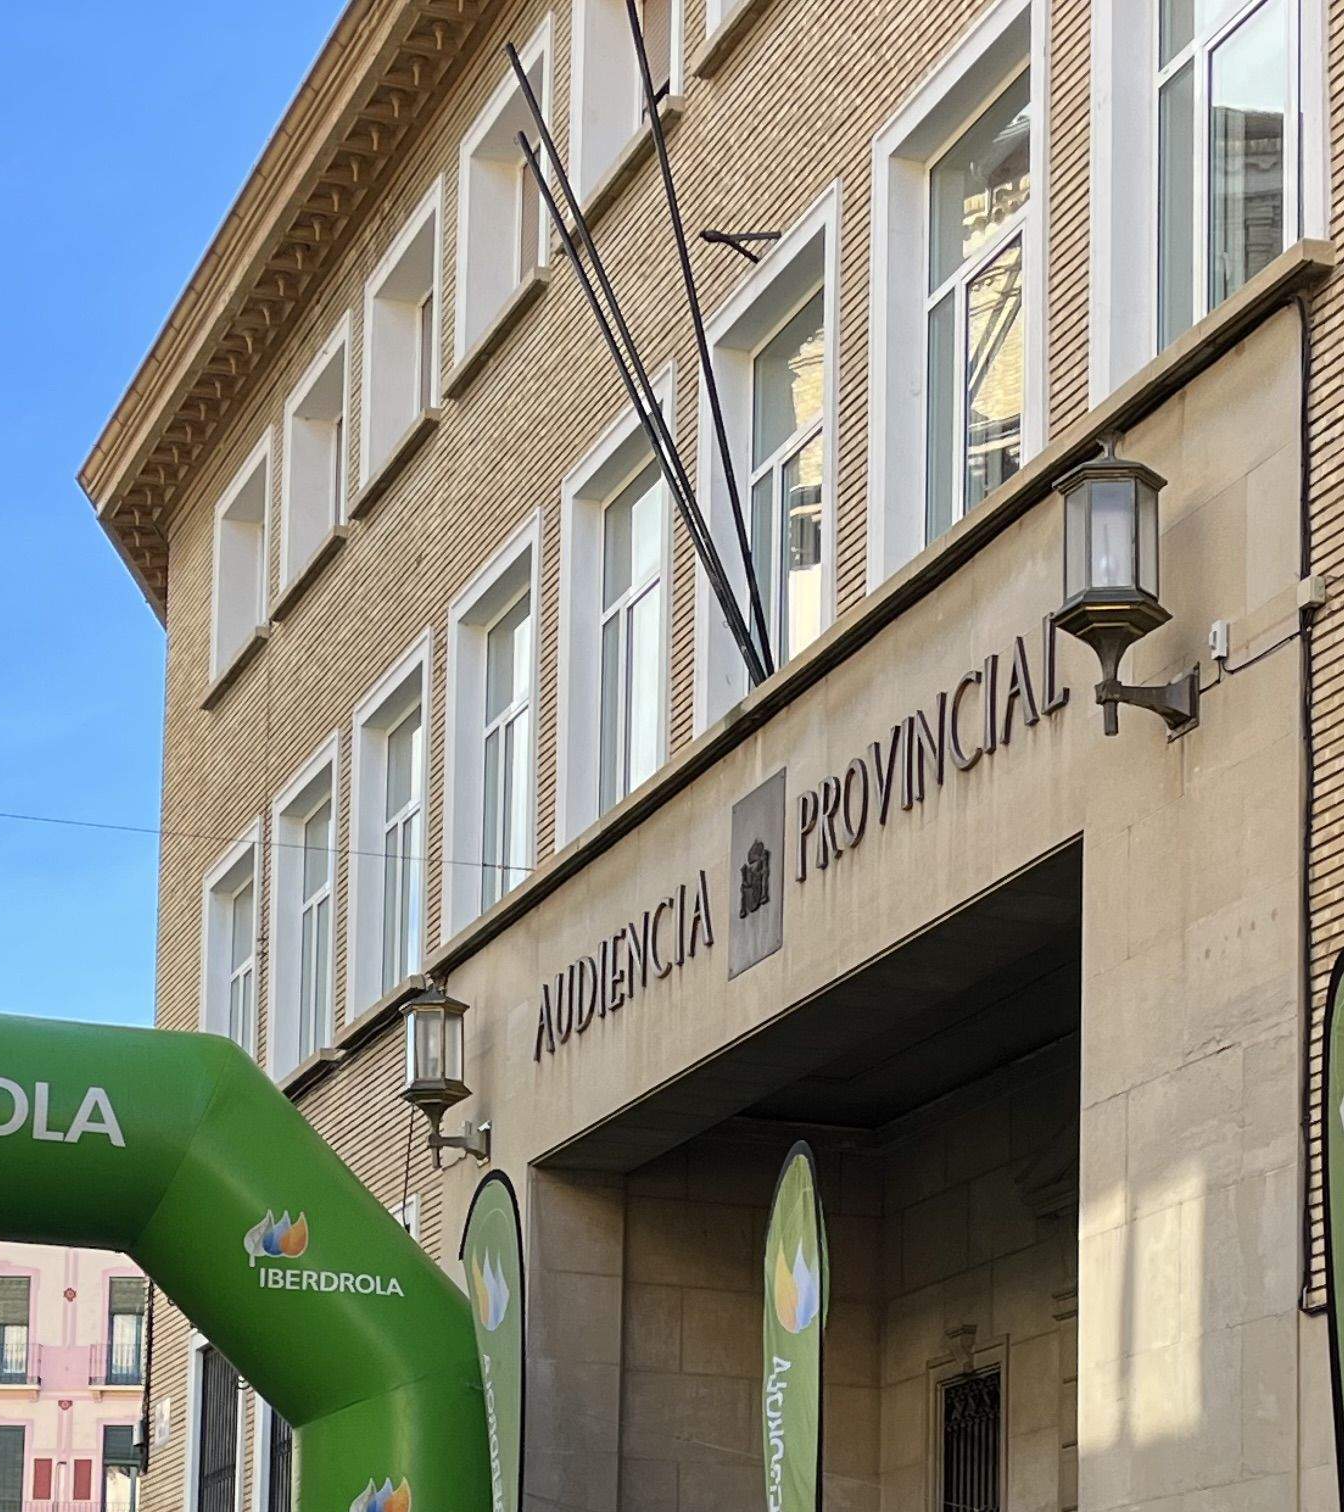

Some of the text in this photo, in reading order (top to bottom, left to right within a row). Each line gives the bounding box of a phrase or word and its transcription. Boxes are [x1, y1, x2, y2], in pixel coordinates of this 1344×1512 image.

[533, 611, 1071, 1063] AUDIENCIA PROVINCIAL
[259, 1267, 405, 1297] IBERDROLA
